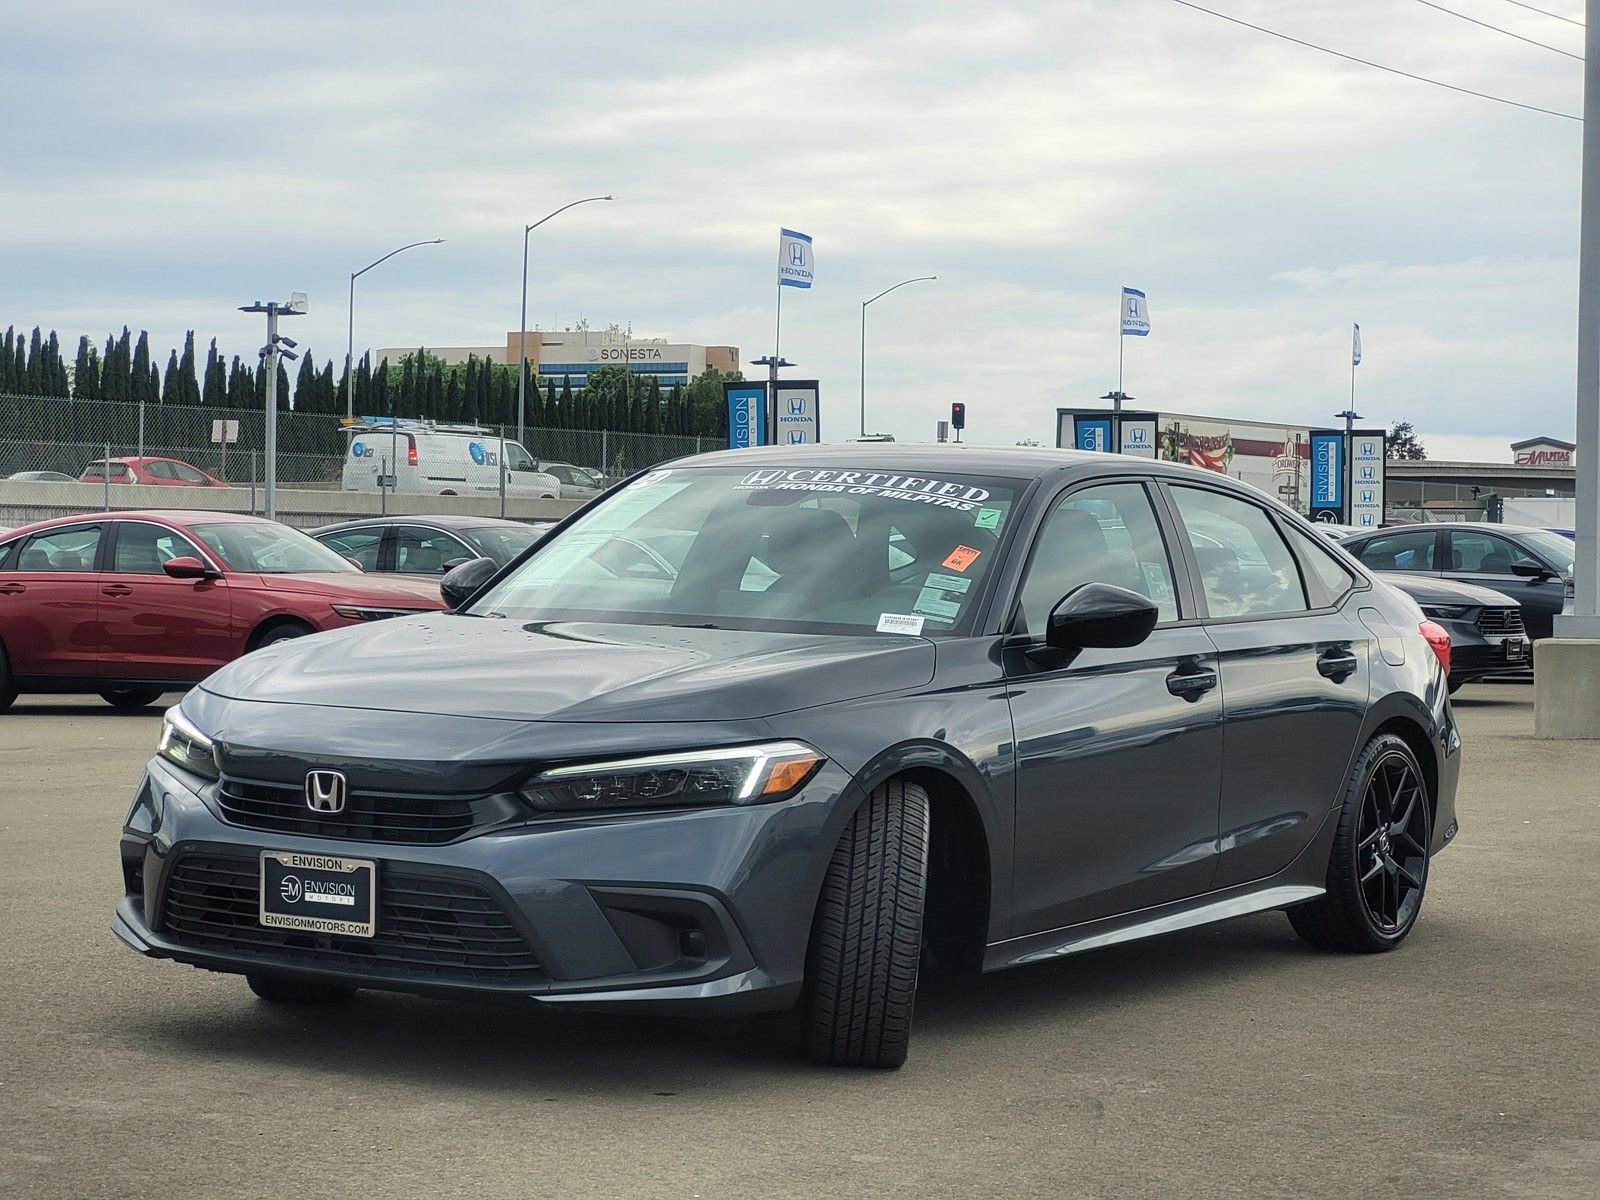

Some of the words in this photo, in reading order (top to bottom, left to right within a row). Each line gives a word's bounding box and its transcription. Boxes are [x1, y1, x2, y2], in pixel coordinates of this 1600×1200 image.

[781, 267, 814, 279] HONDA
[601, 348, 662, 360] SONESTA
[1318, 441, 1328, 502] ENVISION
[786, 469, 990, 502] CERTIFIED
[775, 482, 846, 493] HONDA
[847, 486, 880, 495] OF
[877, 489, 976, 512] MILPITAS
[292, 855, 342, 870] ENVISION
[304, 880, 355, 896] ENVISION
[308, 894, 352, 904] MOTORS
[265, 915, 369, 935] ENVISIONMOTORS.COM
